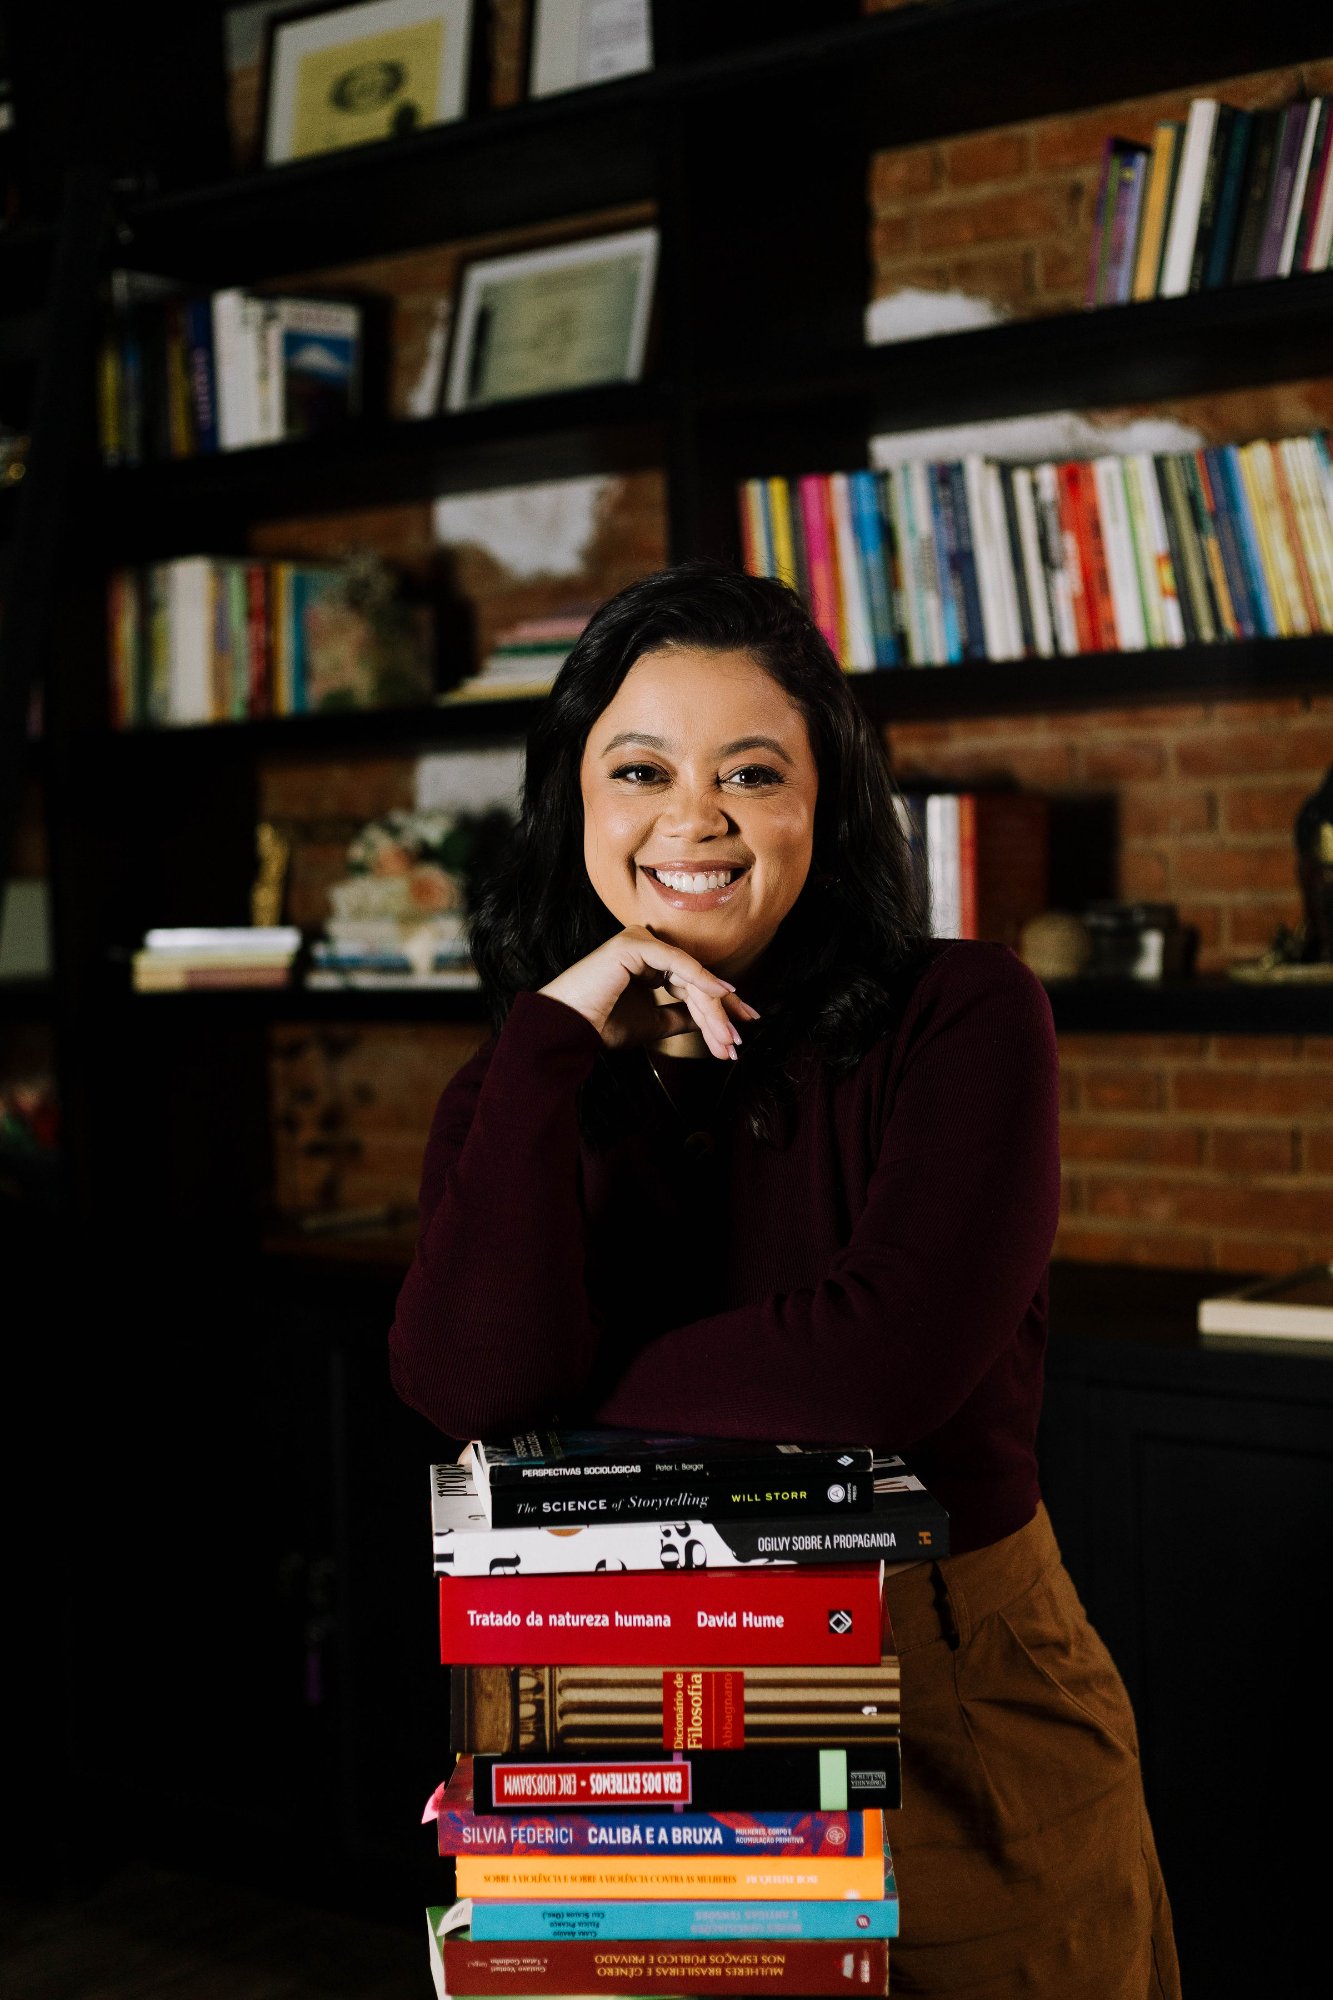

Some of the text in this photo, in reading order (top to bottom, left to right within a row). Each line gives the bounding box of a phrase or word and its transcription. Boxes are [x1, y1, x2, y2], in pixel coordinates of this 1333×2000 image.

[521, 1464, 641, 1478] PERSPECTIVAS SOCIOLÓGICAS
[516, 1491, 710, 1514] The SCIENCE of Storytelling
[731, 1491, 808, 1502] WILL STORR
[757, 1532, 897, 1552] OGILVY SOBRE A PROPAGANDA
[467, 1610, 671, 1627] Tratado da natureza humana
[697, 1611, 785, 1628] David Hume
[673, 1673, 684, 1750] Dicionário de
[687, 1673, 703, 1750] Filosofia
[722, 1673, 735, 1749] Abbagnano
[504, 1773, 557, 1796] HOBSBAWM
[558, 1773, 577, 1795] ERIC
[590, 1772, 641, 1795] EXTREMOS
[642, 1772, 662, 1794] DOS
[664, 1772, 682, 1794] ERA
[462, 1827, 573, 1844] SILVIA FEDERICI
[588, 1825, 723, 1845] CALIBÃ E A BRUXA
[775, 1836, 804, 1845] PRIMITIVA
[483, 1874, 510, 1883] SOBRE
[570, 1874, 597, 1883] SOBRE
[650, 1874, 684, 1883] CONTRA
[696, 1874, 737, 1883] MULHERES
[594, 1953, 785, 1965] NOS ESPAÇOS PÚBLICO E PRIVADO
[597, 1967, 784, 1978] MULHERES BRASILEIRAS E GÊNERO
